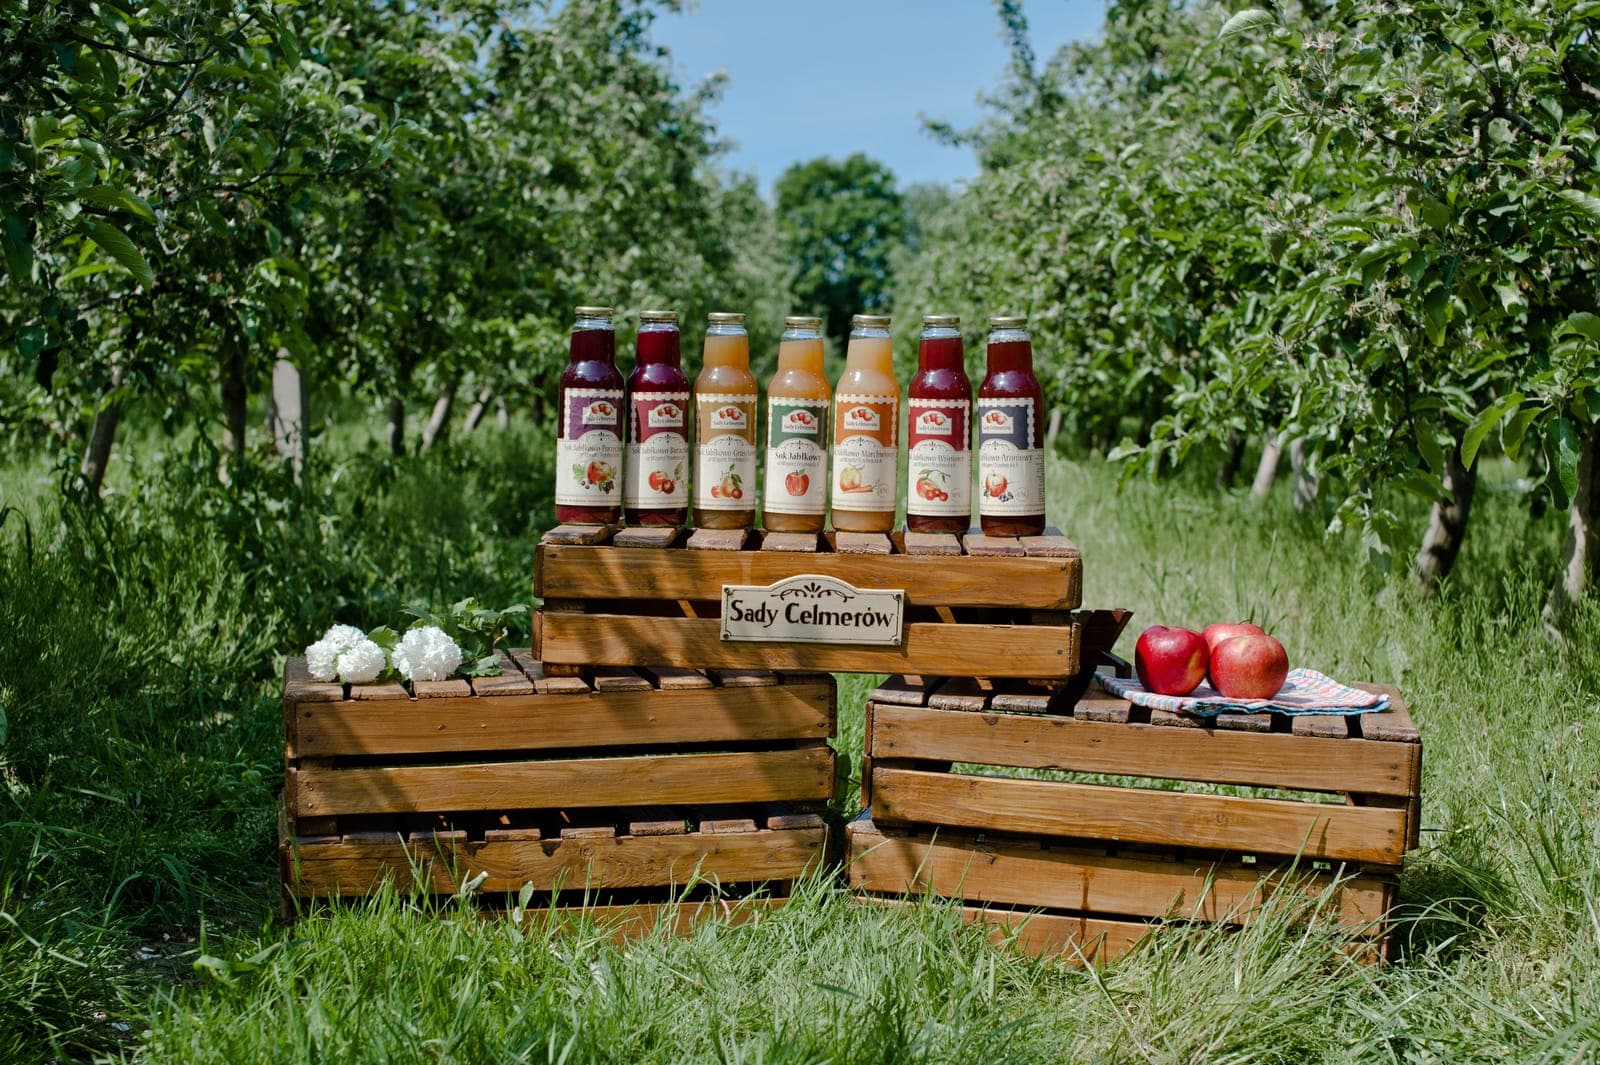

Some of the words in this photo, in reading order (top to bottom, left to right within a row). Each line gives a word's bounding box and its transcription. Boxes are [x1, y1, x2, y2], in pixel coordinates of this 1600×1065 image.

[775, 451, 787, 460] Sok
[787, 451, 821, 461] Jabłkowy
[730, 599, 779, 628] Sady
[784, 602, 895, 628] Celmerów
